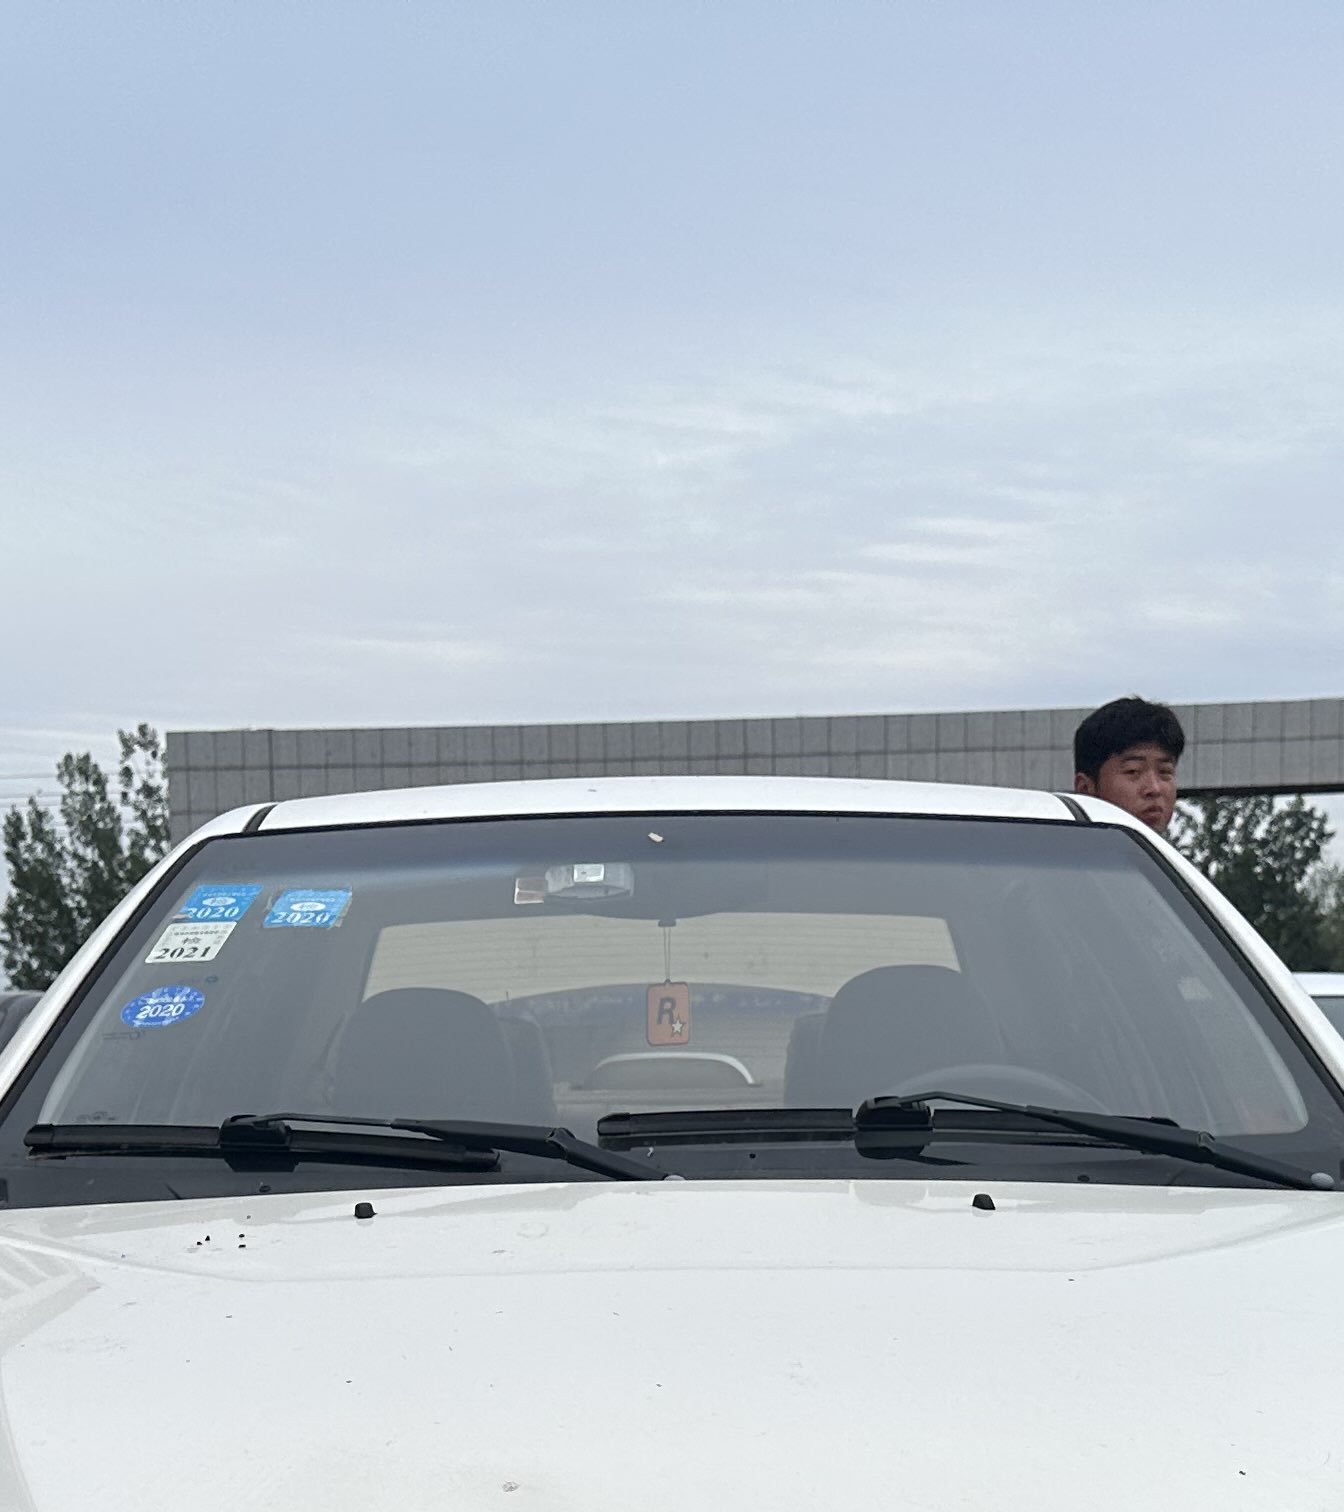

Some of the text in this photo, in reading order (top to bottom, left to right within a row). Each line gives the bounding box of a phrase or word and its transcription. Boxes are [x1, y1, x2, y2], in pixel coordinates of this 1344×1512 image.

[186, 905, 240, 920] 2020
[271, 911, 331, 924] 2020
[154, 946, 212, 960] 2021
[136, 1003, 186, 1020] 2020
